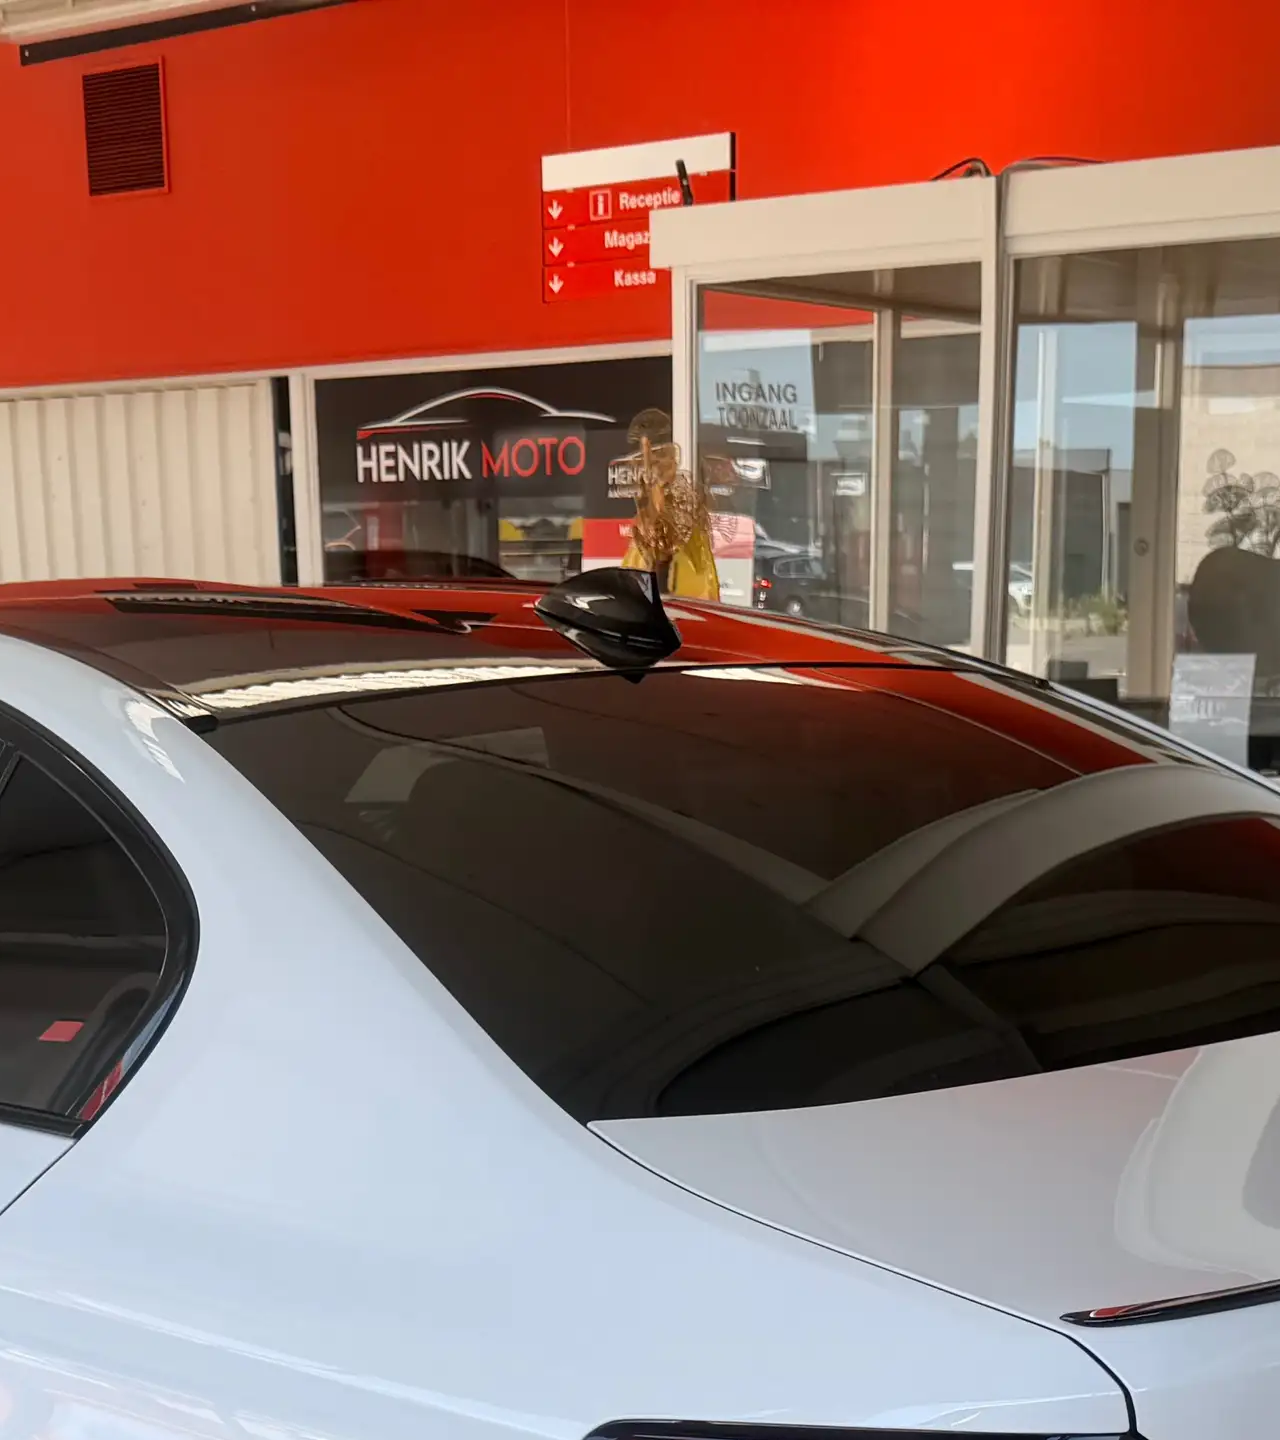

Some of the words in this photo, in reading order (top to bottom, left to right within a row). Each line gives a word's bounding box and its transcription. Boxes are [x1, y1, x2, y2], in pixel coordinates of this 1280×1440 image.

[619, 187, 681, 210] Receptie
[614, 269, 656, 287] Kassa
[716, 382, 797, 404] INGANG
[717, 407, 798, 430] TOONZAAL
[357, 440, 472, 483] HENRIK
[481, 436, 586, 478] MOTO
